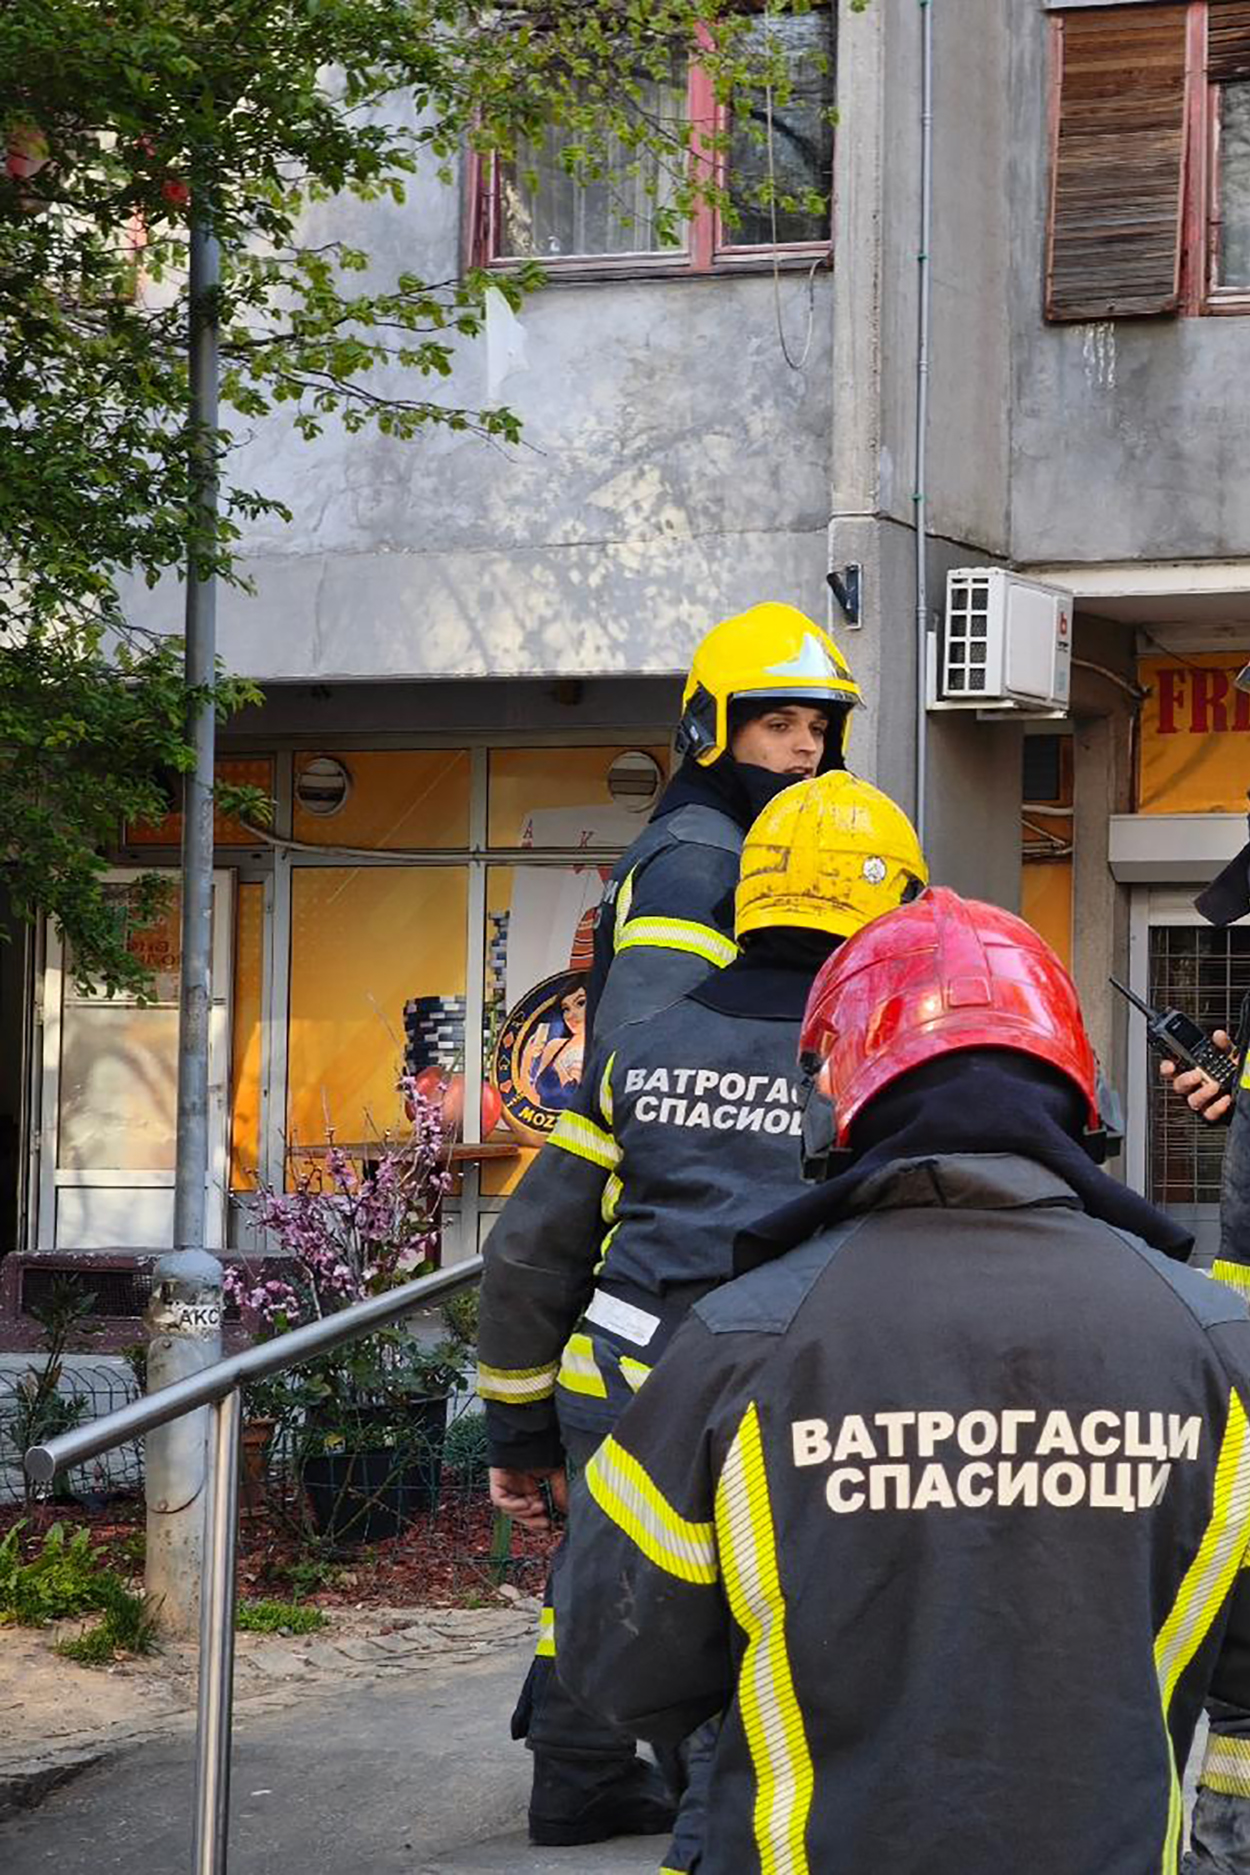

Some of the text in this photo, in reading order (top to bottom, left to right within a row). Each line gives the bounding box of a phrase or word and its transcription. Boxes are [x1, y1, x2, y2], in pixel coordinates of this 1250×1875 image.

[624, 1068, 798, 1104] ВАТРОГА
[791, 1410, 1202, 1467] ВАТРОГАСЦИ
[825, 1461, 1172, 1514] СПАСИОЦИ
